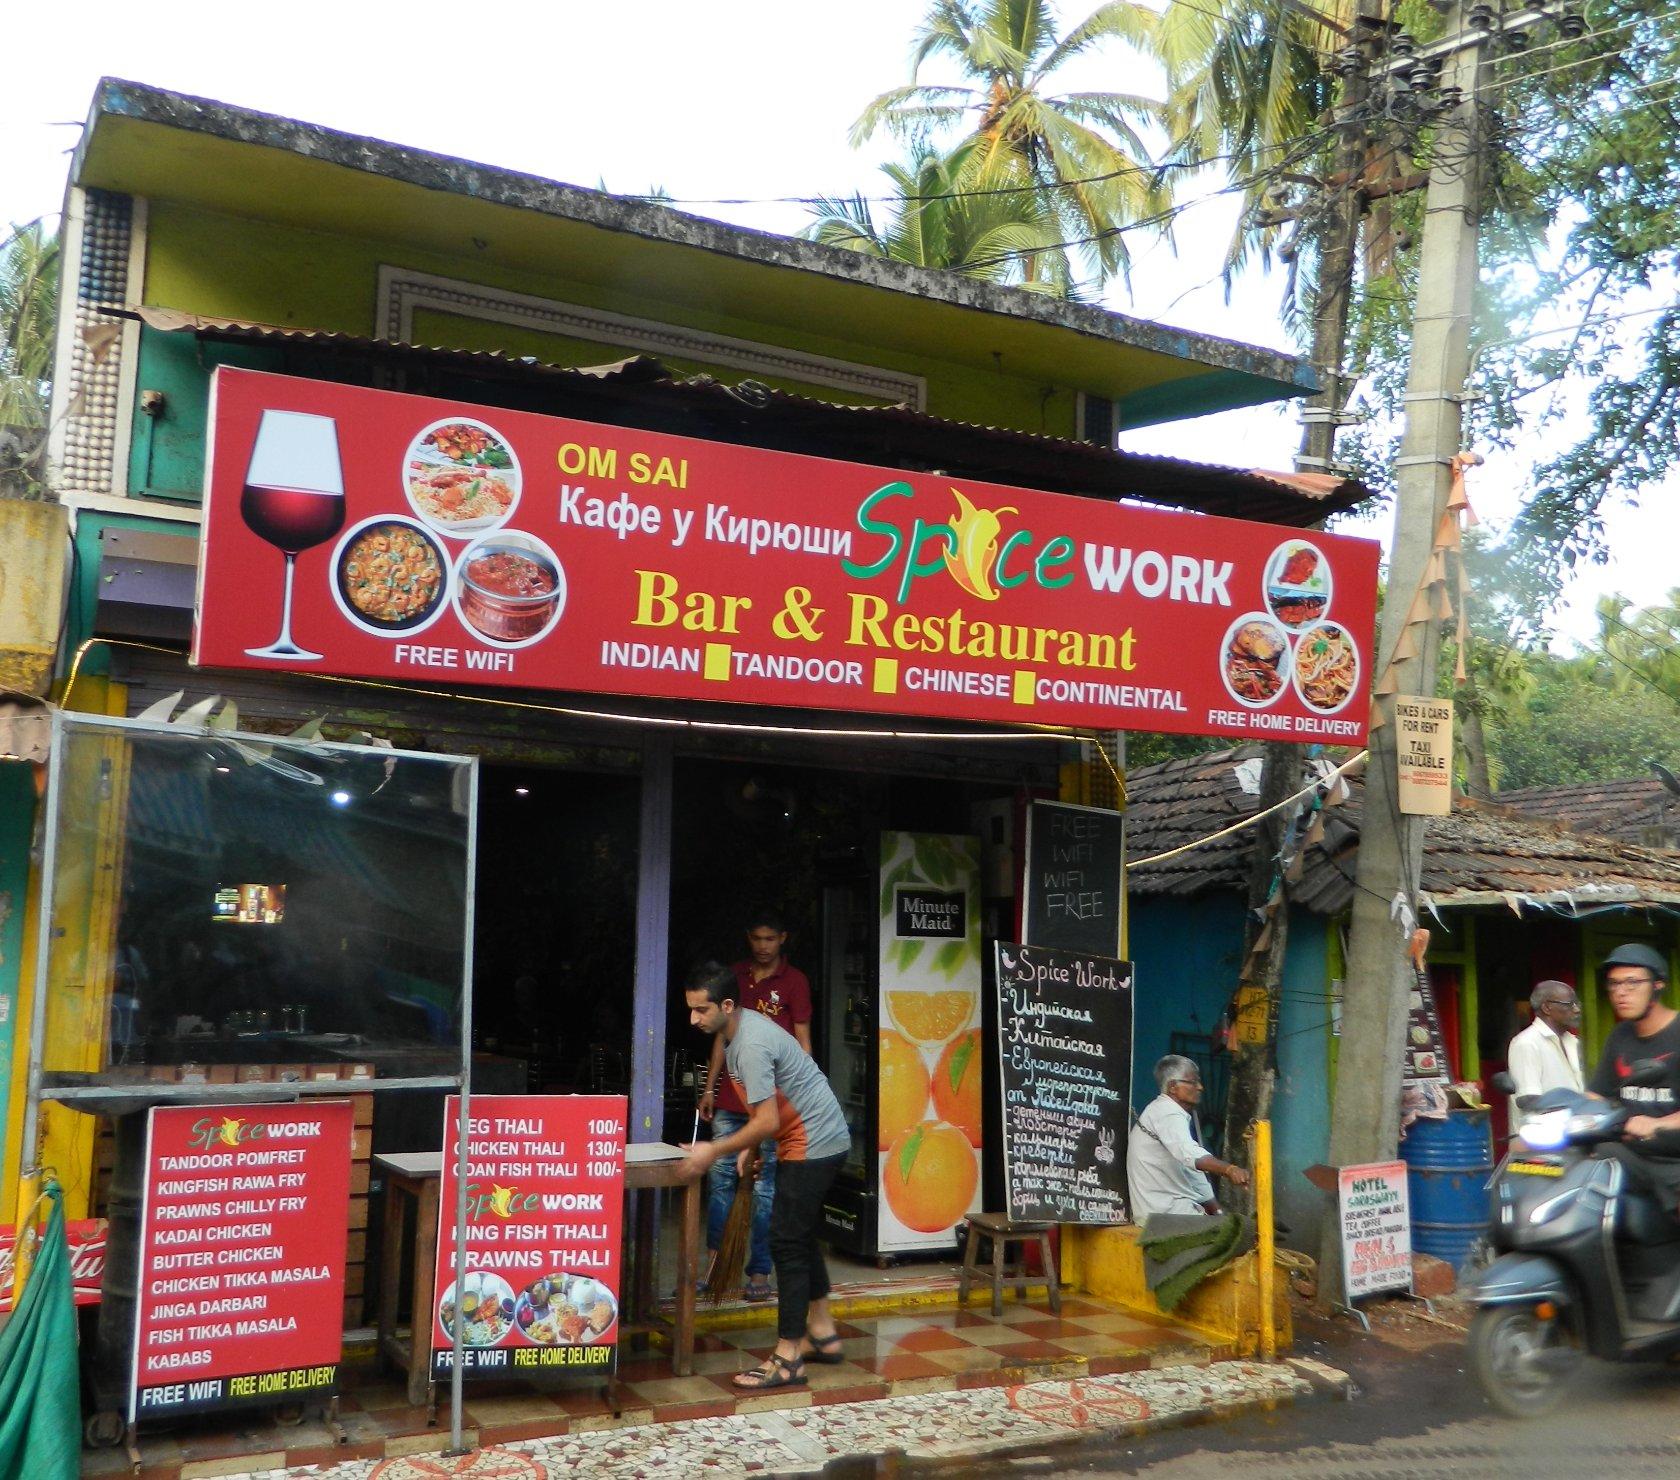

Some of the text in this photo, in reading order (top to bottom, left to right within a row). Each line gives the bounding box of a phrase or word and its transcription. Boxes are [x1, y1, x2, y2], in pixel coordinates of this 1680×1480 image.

[557, 442, 688, 489] OM SAI
[558, 484, 852, 556] Кафе у Кирюши
[841, 481, 1234, 606] Spice WORK
[631, 569, 1137, 671] Bar & Restaurant
[394, 644, 514, 672] FREE WIFI
[601, 640, 1188, 712] INDIAN TANDOOR CHINESE CONTINENTAL
[1208, 708, 1361, 736] FREE HOME DELIVERY
[1427, 708, 1449, 720] CARS
[1403, 720, 1439, 734] FOR RENT
[1410, 741, 1432, 753] TAXI
[1050, 813, 1101, 839] FREE
[1044, 870, 1085, 888] WIFI
[903, 897, 960, 915] Minute
[1047, 892, 1104, 920] FREE
[910, 914, 952, 931] Maid
[1015, 949, 1069, 996] Spice
[187, 1116, 322, 1150] Spice WORK
[495, 1118, 543, 1135] THALI
[588, 1119, 623, 1135] 100/-
[159, 1149, 306, 1171] TANDOOR POMFRET
[523, 1141, 565, 1156] THALI
[587, 1141, 622, 1156] 130/-
[499, 1162, 532, 1177] FISH
[536, 1162, 578, 1177] THALI
[586, 1161, 622, 1177] 100/-
[157, 1172, 307, 1195] KINGFISH RAWA FRY
[1352, 1177, 1388, 1192] HOTEL
[155, 1196, 307, 1220] PRAWNS CHILLY FRY
[542, 1194, 603, 1211] WORK
[154, 1223, 272, 1245] KADAI CHICKEN
[504, 1224, 547, 1241] FISH
[552, 1224, 608, 1240] THALI
[153, 1246, 283, 1271] BUTTER CHICKEN
[549, 1249, 610, 1268] THALI
[151, 1265, 330, 1295] CHICKEN TIKKA MASALA
[150, 1295, 267, 1320] JINGA DARBARI
[148, 1316, 297, 1344] FISH TIKKA MASALA
[147, 1350, 212, 1370] KABABS
[436, 1346, 611, 1367] FRE WIFI FREE HOME DELIVERY
[142, 1366, 336, 1407] FREE WIFI FREE HOME DELIVERY
